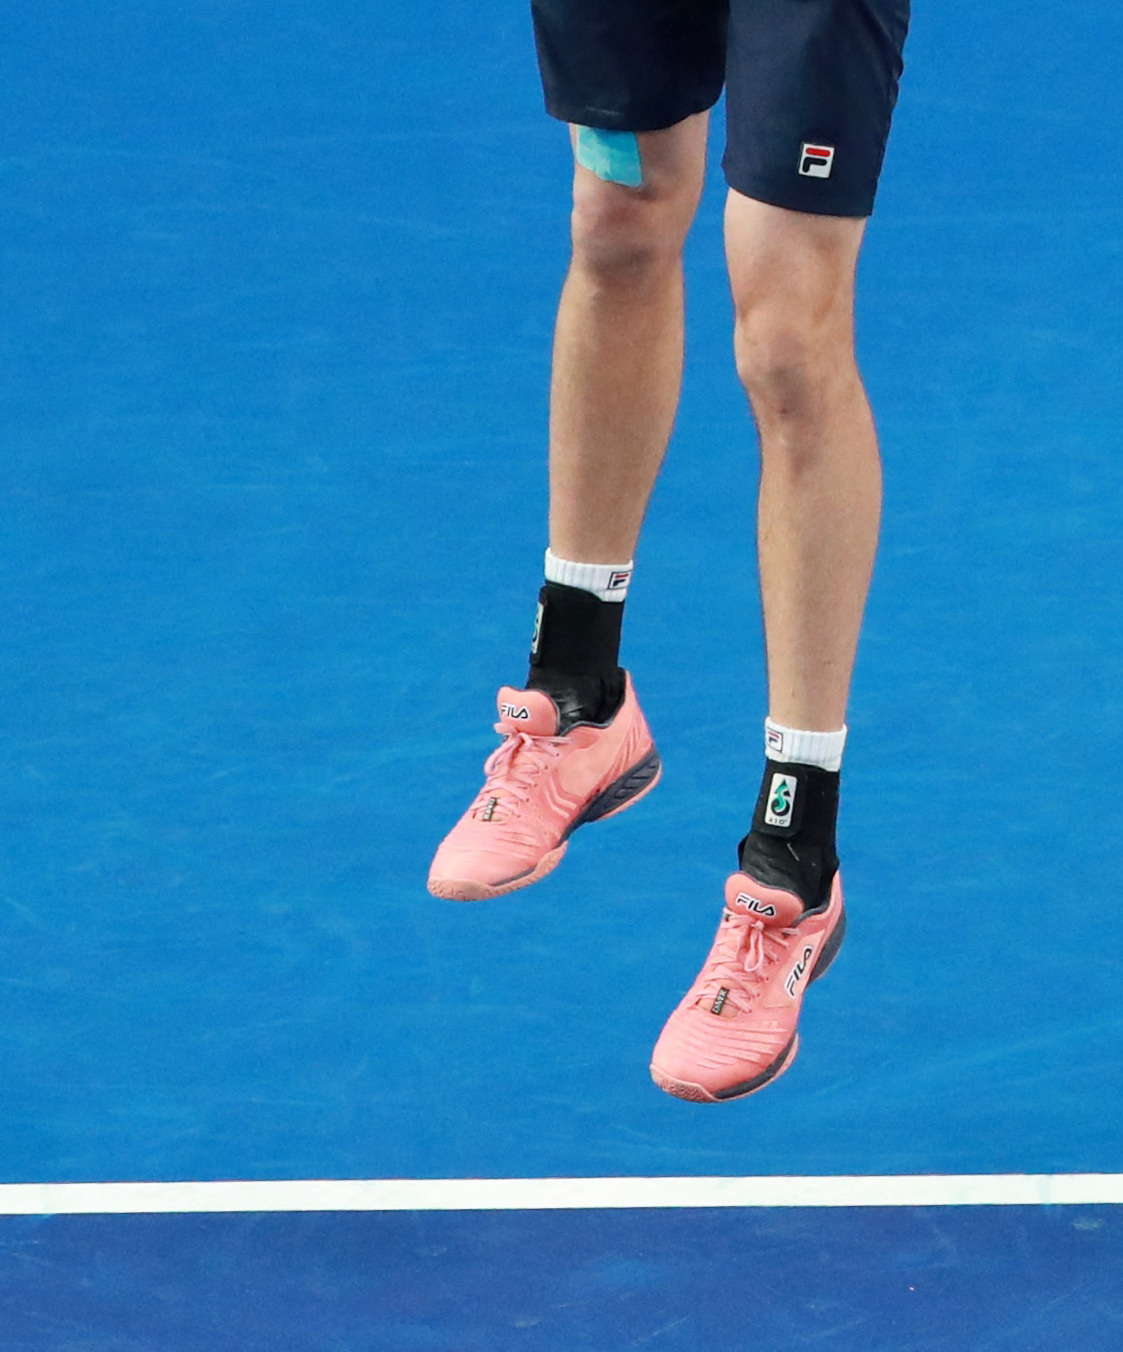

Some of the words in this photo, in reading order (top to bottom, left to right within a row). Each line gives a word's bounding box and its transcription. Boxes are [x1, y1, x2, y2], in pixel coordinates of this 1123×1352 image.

[500, 702, 530, 720] FILA
[736, 892, 777, 916] FILA
[784, 944, 813, 998] FILA
